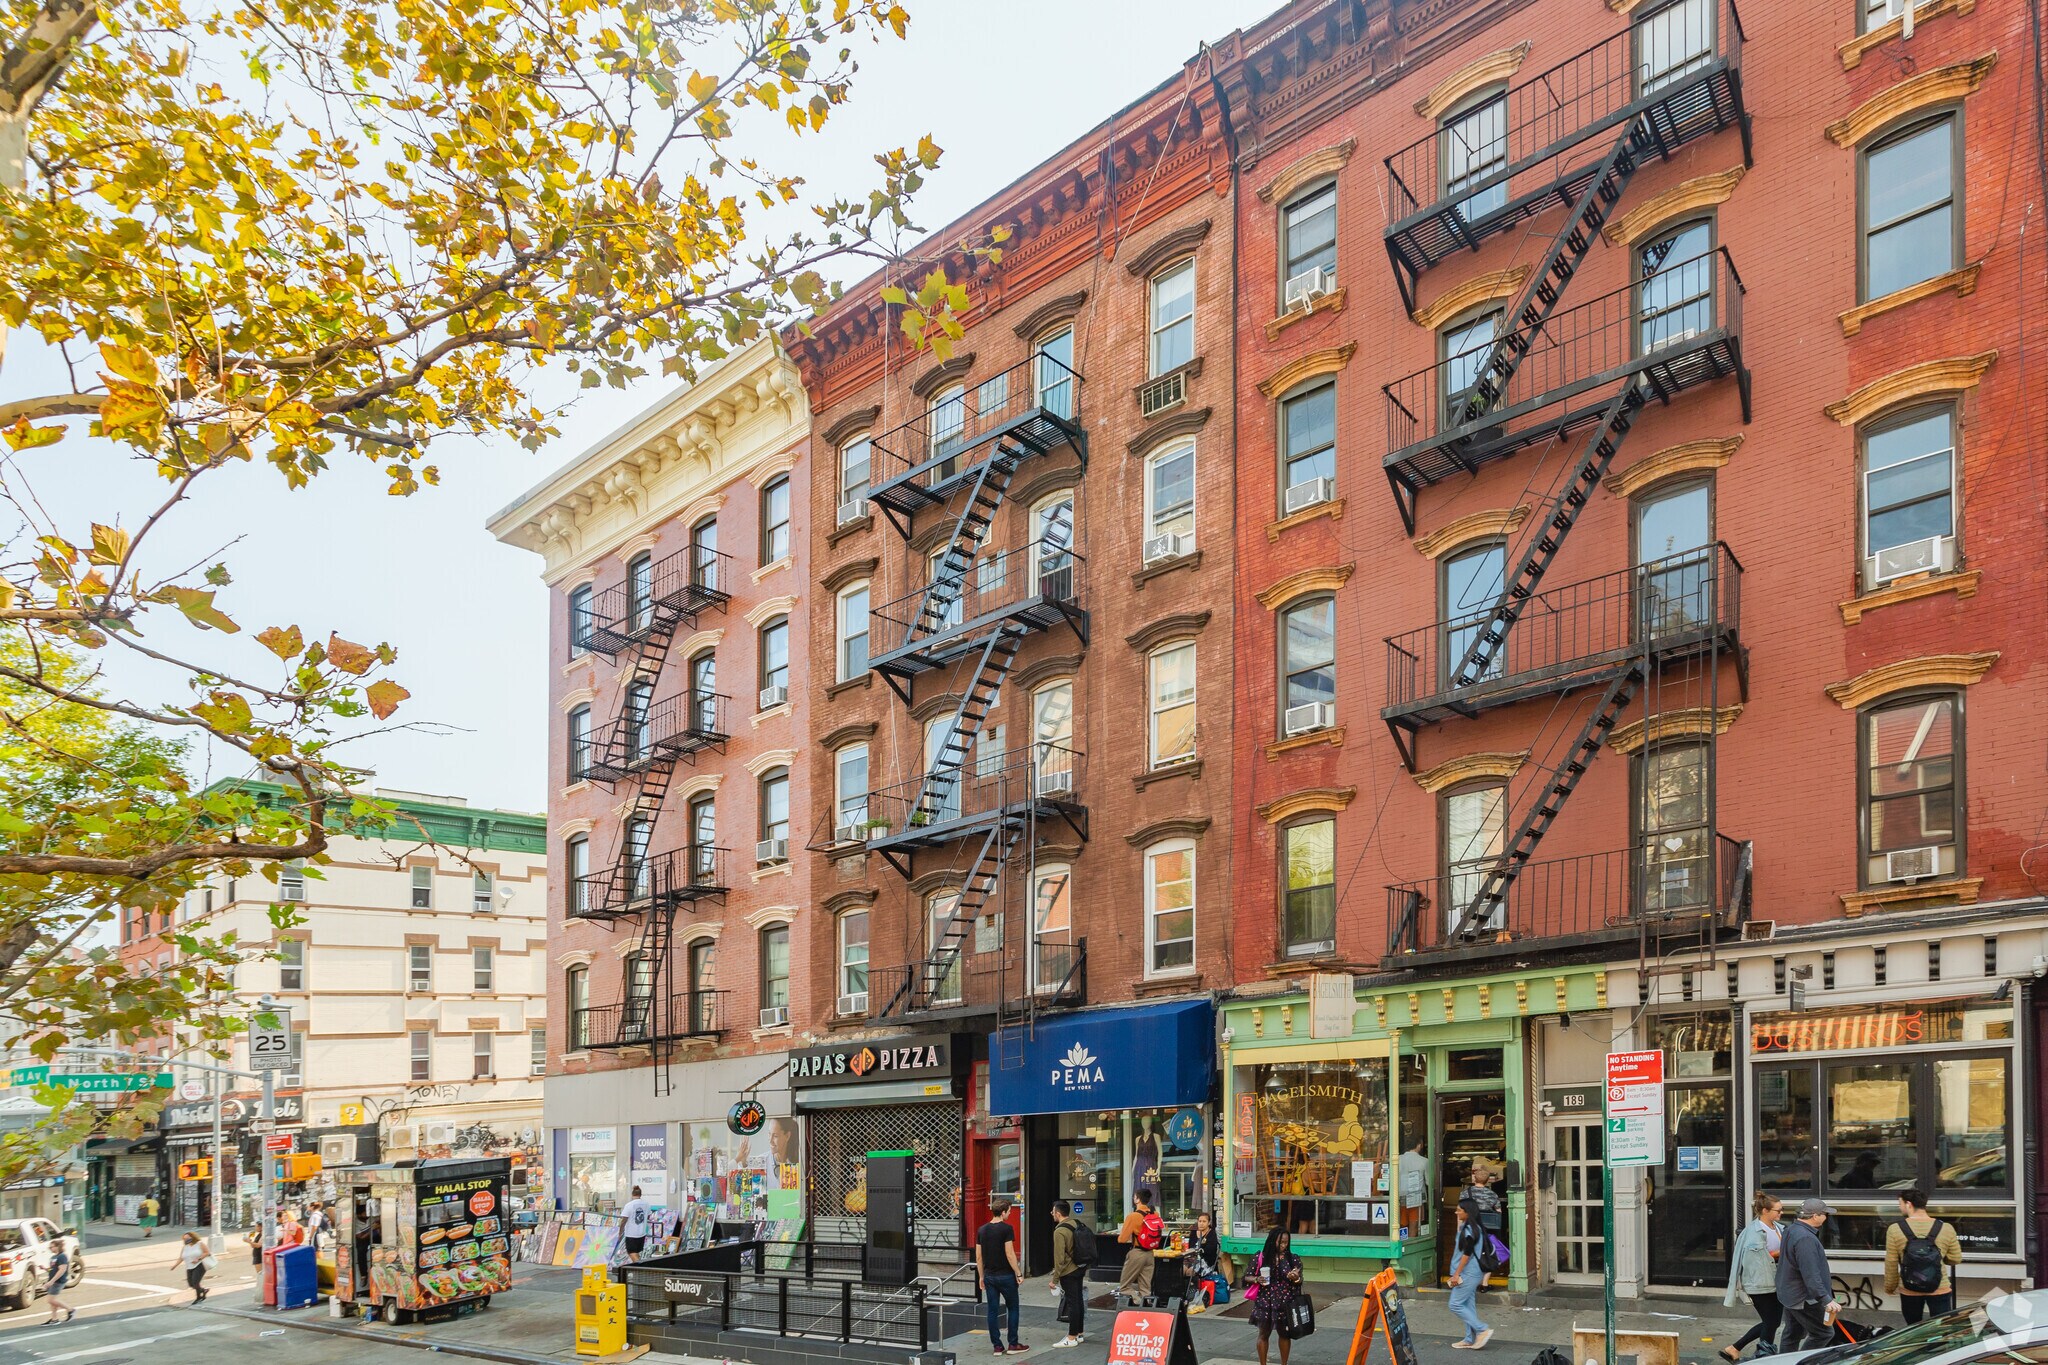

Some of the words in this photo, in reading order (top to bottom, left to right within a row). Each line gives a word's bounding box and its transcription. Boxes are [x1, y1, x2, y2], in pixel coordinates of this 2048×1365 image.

[1754, 1029, 1813, 1050] DOS
[1822, 1020, 1924, 1046] OROS
[255, 1035, 286, 1051] 25
[790, 1053, 846, 1077] PAPA'S
[880, 1046, 939, 1071] PIZZA
[1621, 1054, 1655, 1063] STANDING
[1610, 1064, 1639, 1072] Anytime
[67, 1078, 120, 1089] North
[1051, 1067, 1105, 1086] PEMA
[1257, 1085, 1364, 1110] BAGELSMITH
[1565, 1095, 1583, 1106] 189
[1240, 1096, 1253, 1157] BAGELS
[1613, 1118, 1622, 1132] 2
[581, 1131, 612, 1140] MEDRITE
[988, 1129, 1000, 1137] 187
[1176, 1129, 1198, 1140] PEMA
[637, 1138, 664, 1147] COMING
[640, 1151, 662, 1160] SOON!
[435, 1183, 467, 1195] HALAL
[467, 1180, 492, 1190] STOP
[1375, 1206, 1386, 1219] A
[664, 1279, 702, 1296] Subway
[1116, 1333, 1165, 1347] COVID-19
[1116, 1344, 1161, 1358] TESTING
